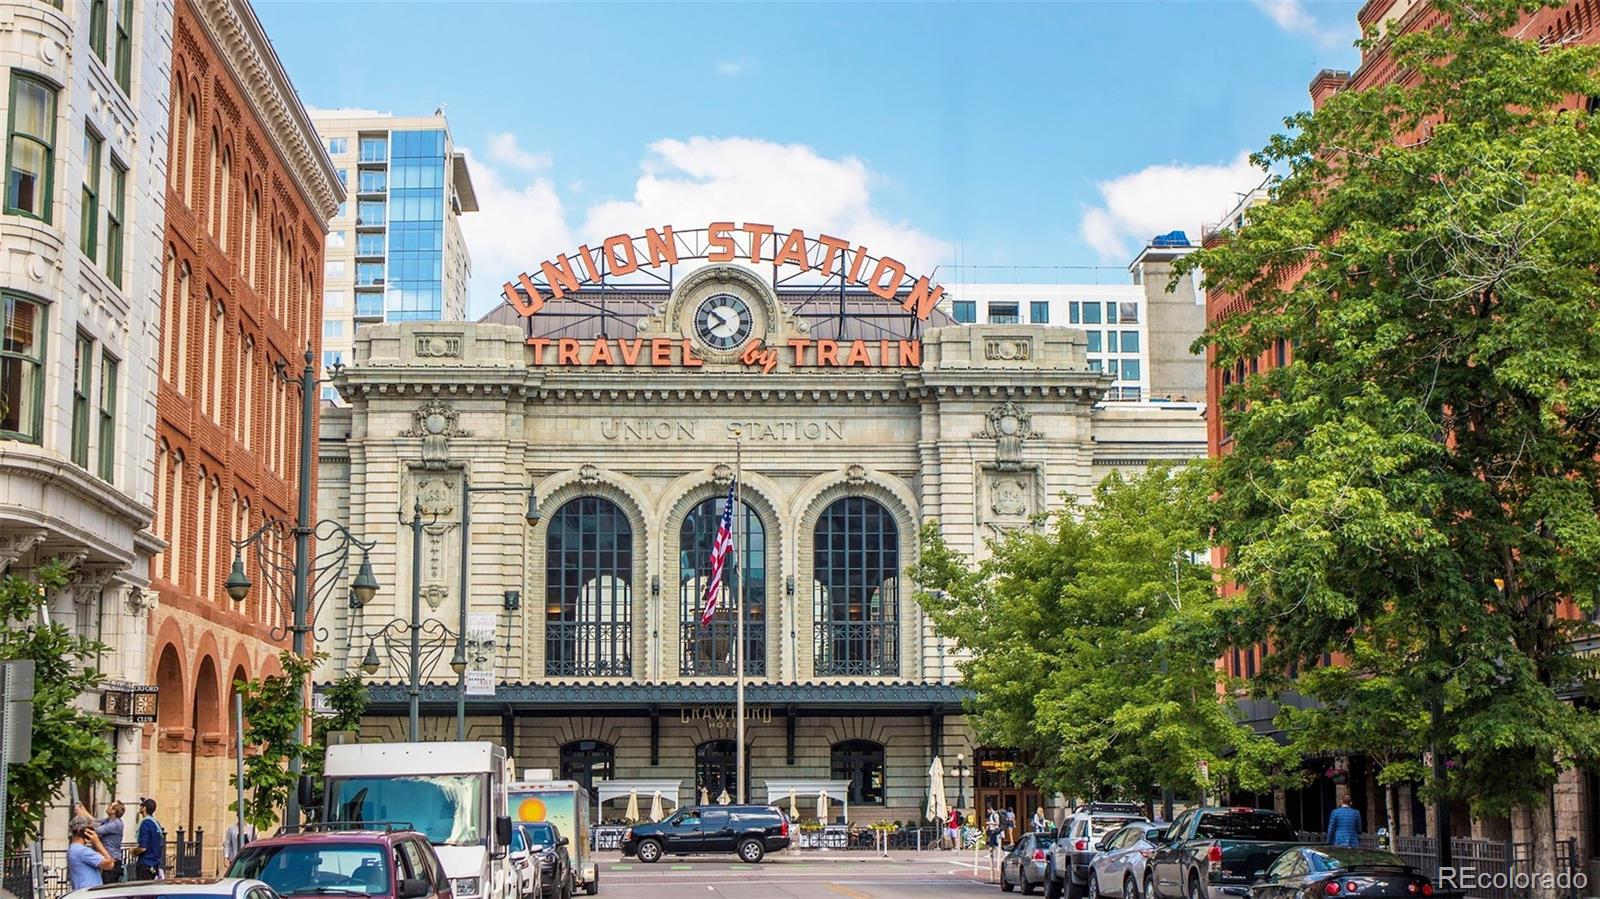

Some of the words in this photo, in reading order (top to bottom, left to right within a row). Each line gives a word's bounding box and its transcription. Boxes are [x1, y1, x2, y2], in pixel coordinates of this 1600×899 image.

[503, 225, 678, 317] UNION
[708, 222, 944, 321] STATION
[526, 337, 703, 367] TRAVEL
[740, 338, 778, 374] by
[787, 338, 921, 367] TRAIN
[601, 422, 696, 440] UNION
[727, 422, 845, 440] STATION
